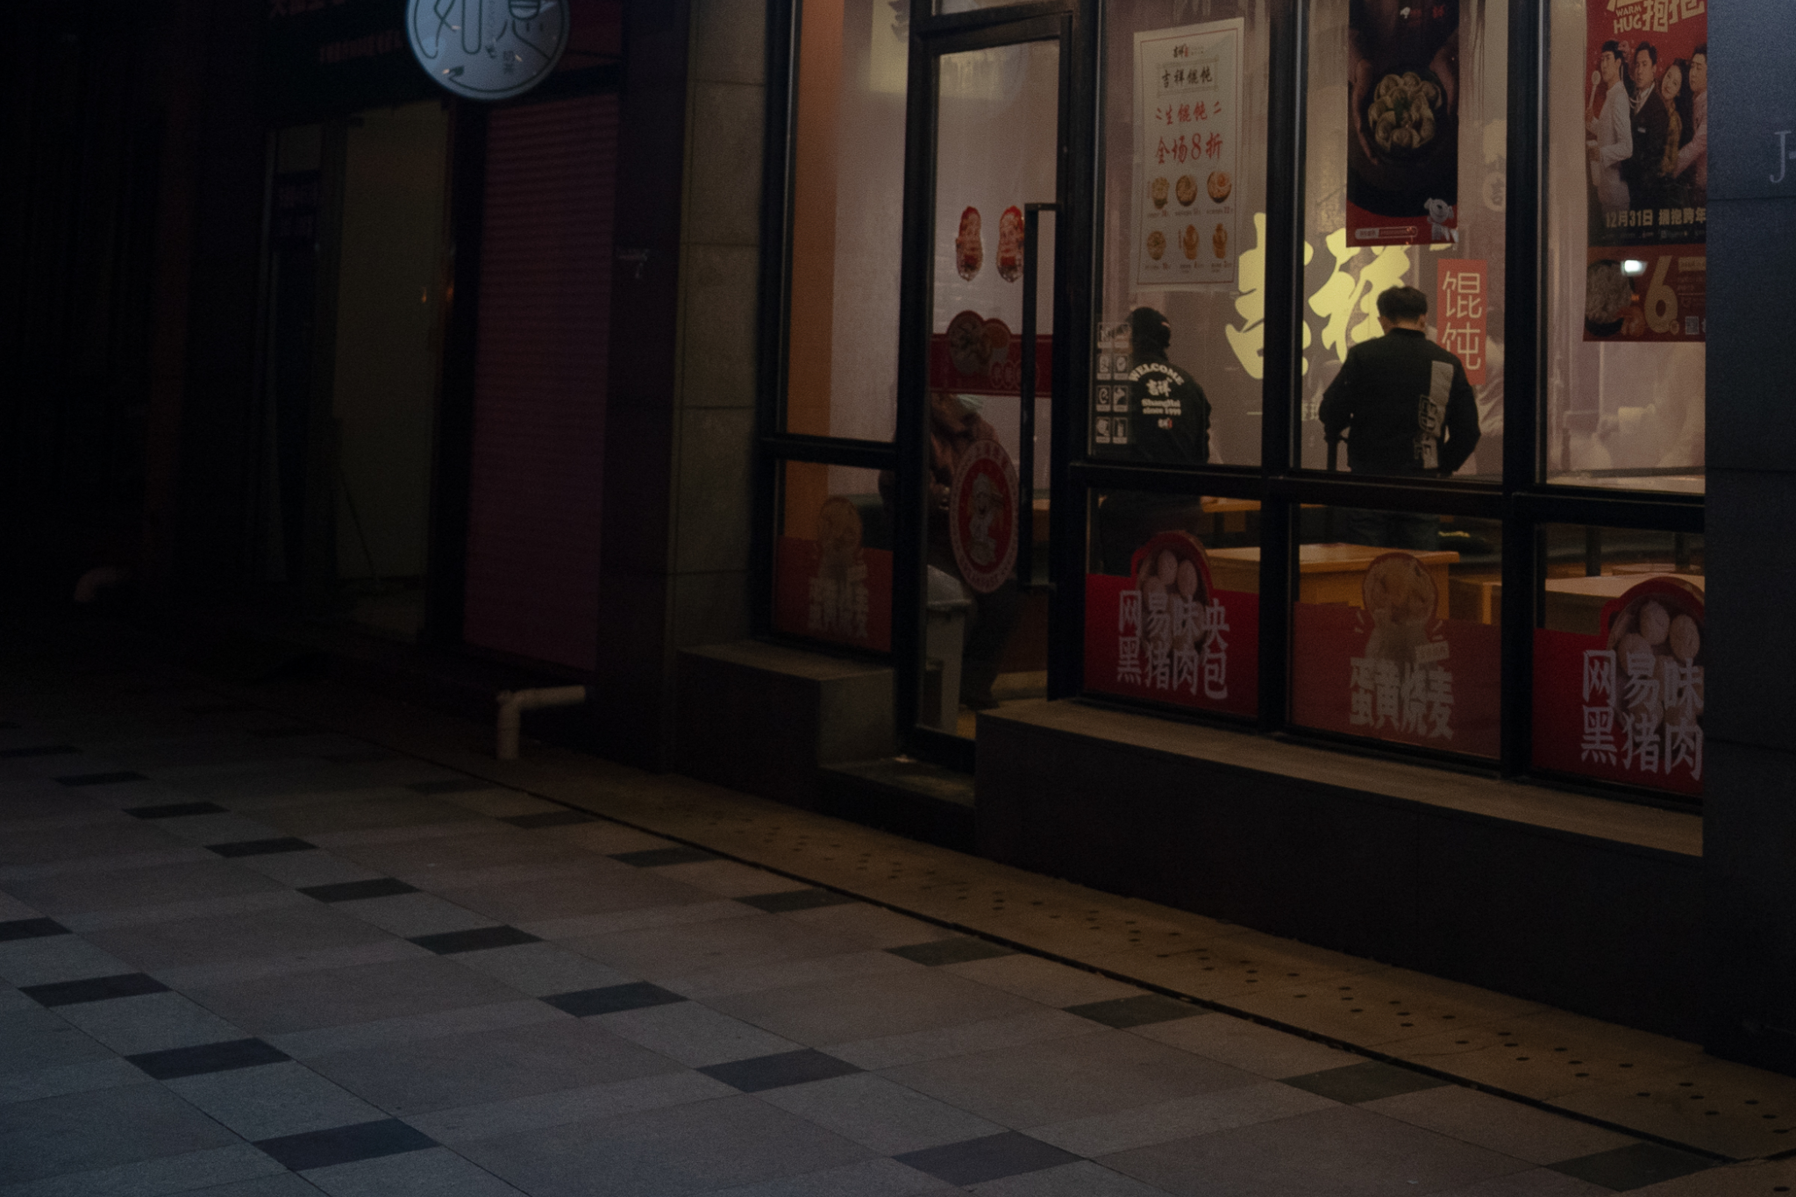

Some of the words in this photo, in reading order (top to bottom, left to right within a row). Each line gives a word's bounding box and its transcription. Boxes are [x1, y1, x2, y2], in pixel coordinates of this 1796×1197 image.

[1613, 17, 1643, 35] HUG
[1616, 2, 1643, 18] WARM
[1154, 131, 1224, 165] 全场8折
[1441, 270, 1483, 372] 馄饨
[1128, 362, 1185, 386] WELCOME
[1118, 588, 1231, 652] 网易味央
[1116, 635, 1229, 700] 黑猪肉包
